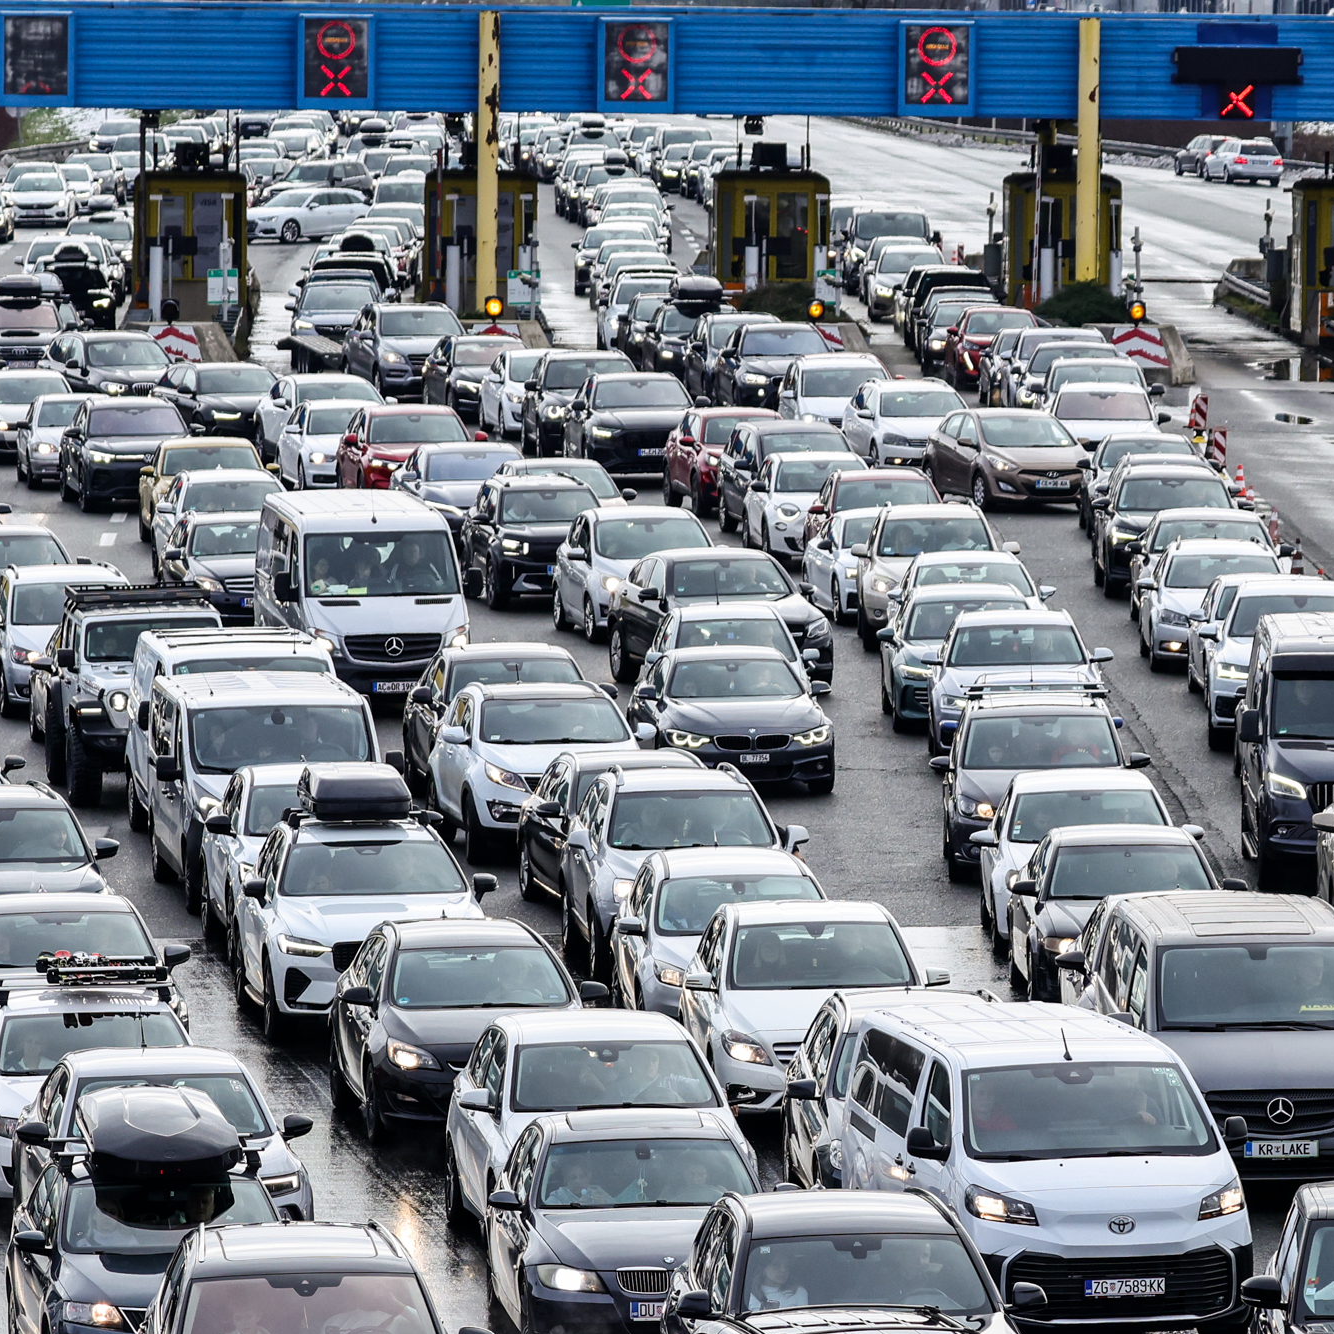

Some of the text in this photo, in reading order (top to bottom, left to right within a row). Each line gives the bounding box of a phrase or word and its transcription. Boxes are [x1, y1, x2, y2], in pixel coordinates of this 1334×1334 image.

[377, 682, 386, 690] AC
[391, 682, 400, 690] OR
[1258, 1143, 1274, 1156] KR
[1282, 1143, 1310, 1155] LAKE
[1093, 1281, 1109, 1294] ZG
[640, 1304, 655, 1317] DU
